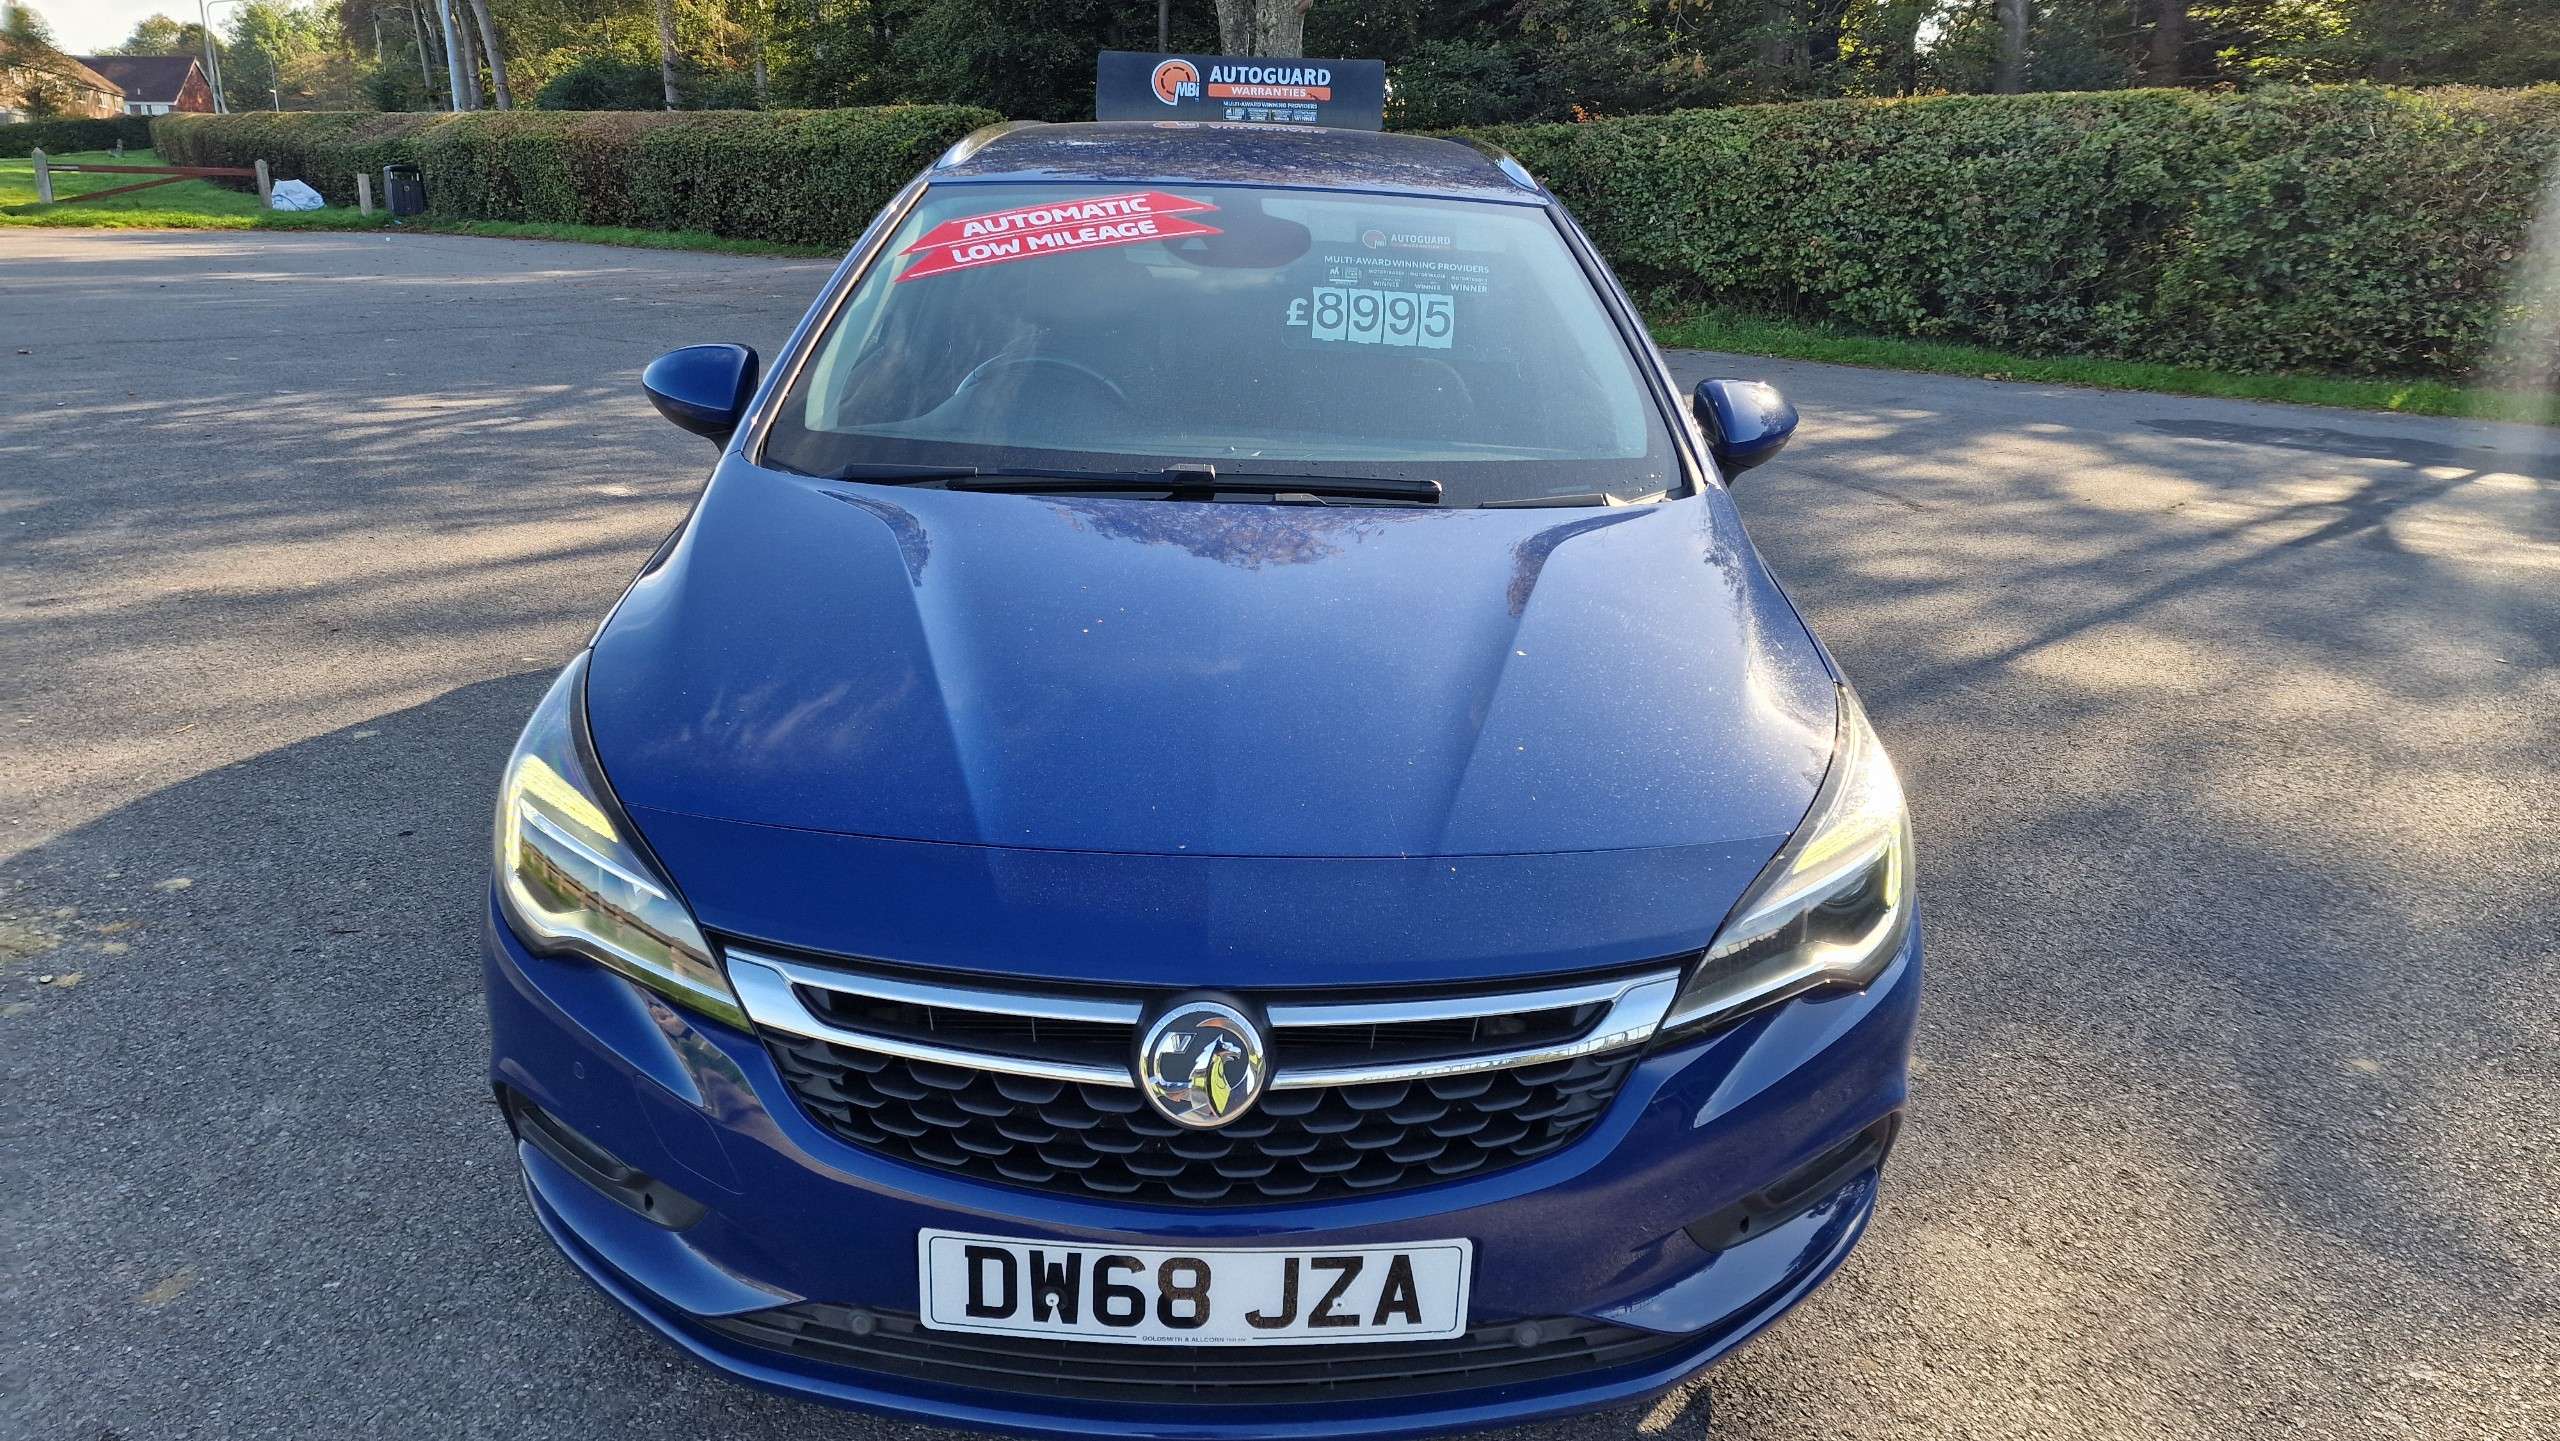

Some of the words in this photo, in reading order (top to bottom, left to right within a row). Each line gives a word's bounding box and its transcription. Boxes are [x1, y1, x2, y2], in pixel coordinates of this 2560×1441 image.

[1209, 65, 1331, 86] AUTOGUARD
[1231, 86, 1307, 98] WARRANTIES
[963, 198, 1151, 238] AUTOMATIC
[952, 239, 1020, 263] LOW
[1029, 220, 1159, 251] MILEAGE
[1391, 233, 1451, 245] AUTOGUARD
[1324, 255, 1391, 267] MULTI-AWARD
[1392, 259, 1436, 270] WINNING
[1437, 262, 1489, 274] PROVIDERS
[1450, 283, 1488, 293] WINNER
[1286, 292, 1451, 338] £8995
[964, 1244, 1213, 1329] DW68
[1244, 1253, 1424, 1329] JZA
